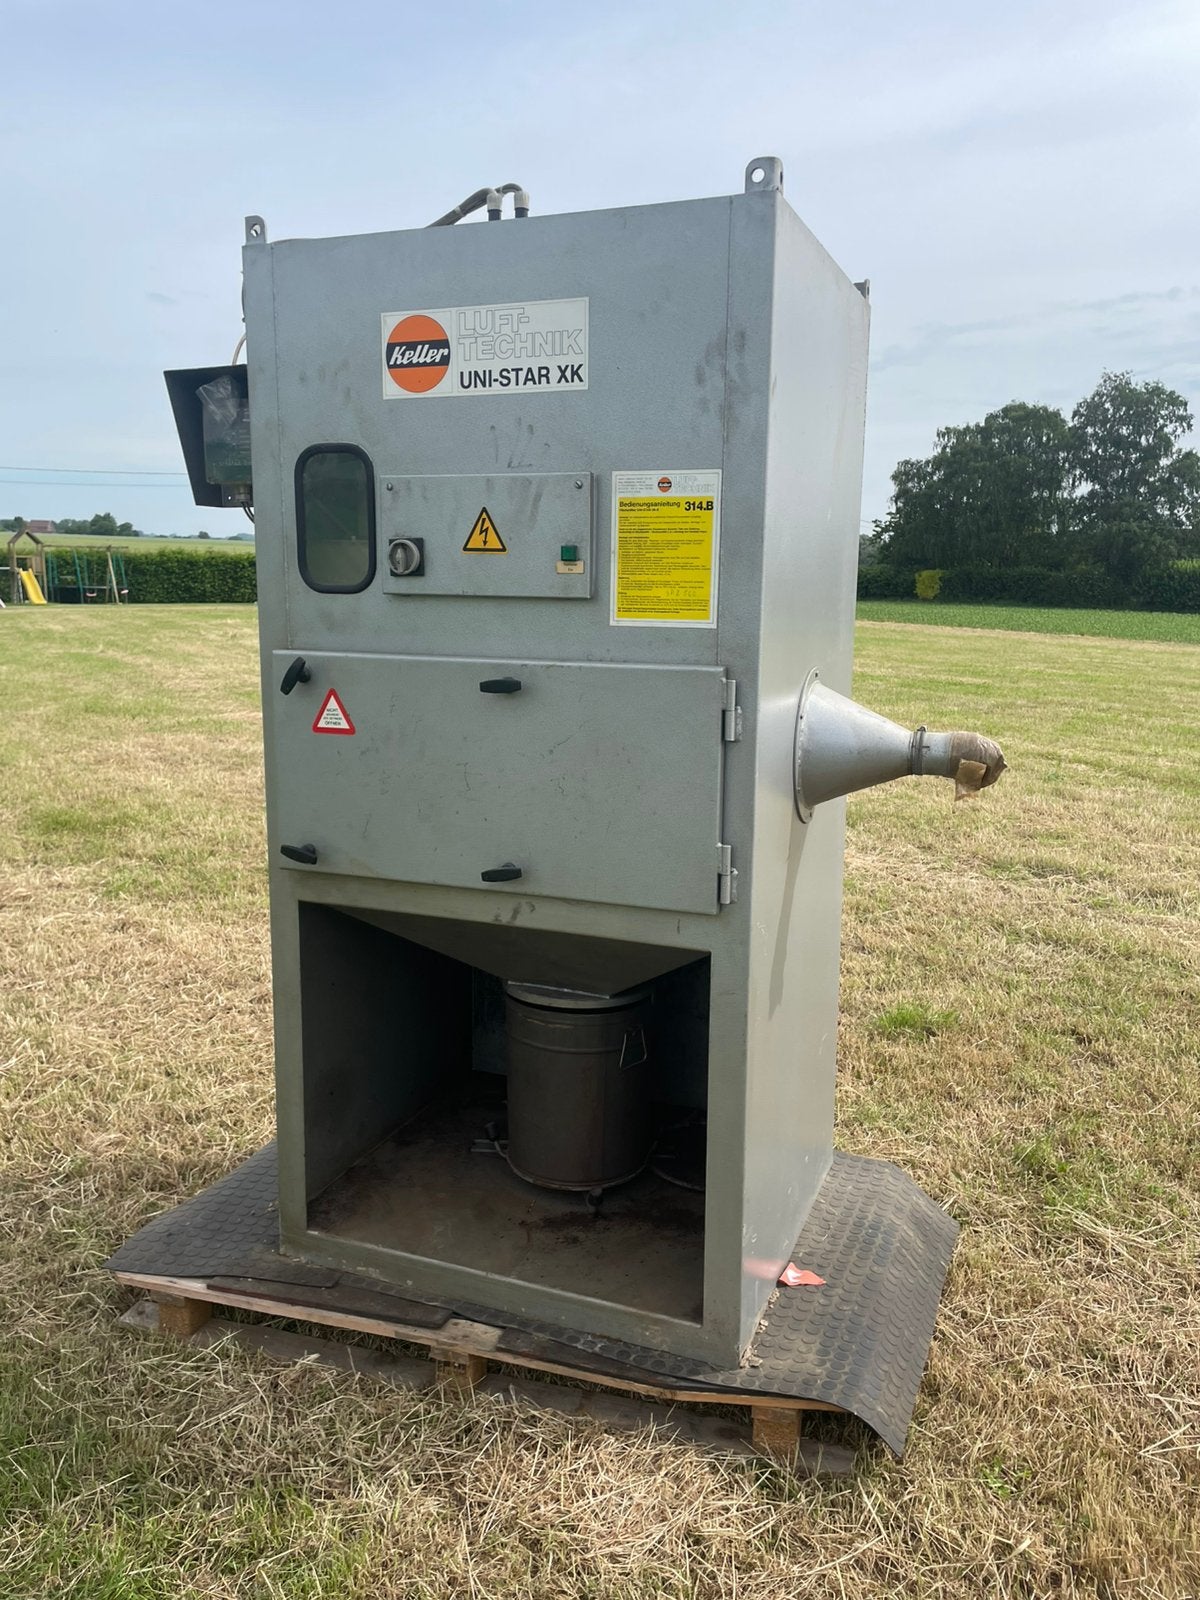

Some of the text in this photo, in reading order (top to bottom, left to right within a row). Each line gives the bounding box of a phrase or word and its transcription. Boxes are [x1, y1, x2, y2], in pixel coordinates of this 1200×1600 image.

[458, 307, 530, 337] LUFT-
[389, 344, 449, 366] Keller
[458, 329, 583, 362] TECHNIK
[460, 363, 584, 389] UNI-STAR XK
[619, 500, 714, 511] Bedienungsanleitung 314.B
